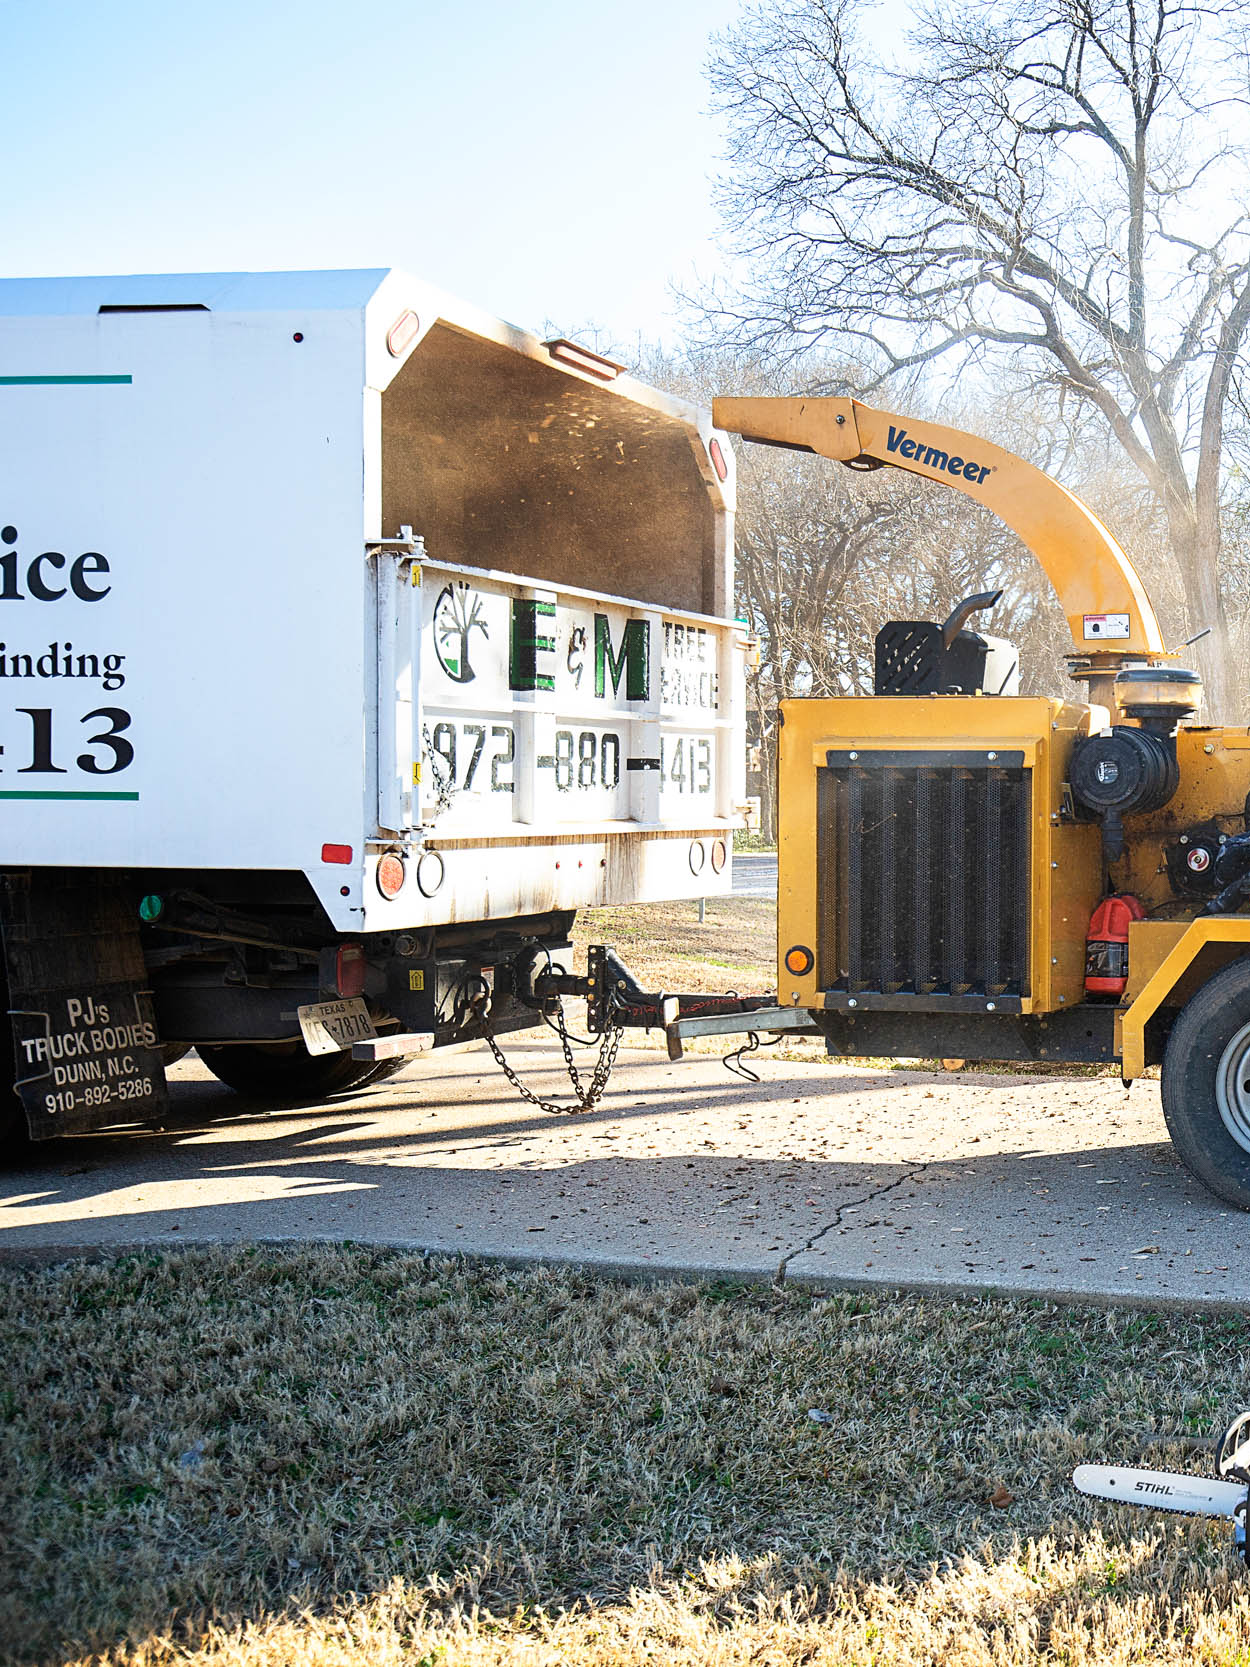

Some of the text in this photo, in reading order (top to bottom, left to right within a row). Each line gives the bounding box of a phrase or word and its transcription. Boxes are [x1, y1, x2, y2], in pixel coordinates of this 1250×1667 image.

[887, 425, 991, 485] Vermeer
[0, 525, 112, 602] ice
[0, 641, 126, 691] inding
[0, 707, 135, 775] 13
[66, 996, 110, 1028] PJ's
[319, 1003, 346, 1016] TEXAS
[21, 1022, 156, 1064] TRUCK BODIES
[54, 1055, 140, 1086] DUNN, N.C.
[45, 1077, 153, 1114] 910-892-5286
[1134, 1481, 1174, 1496] STIHL
